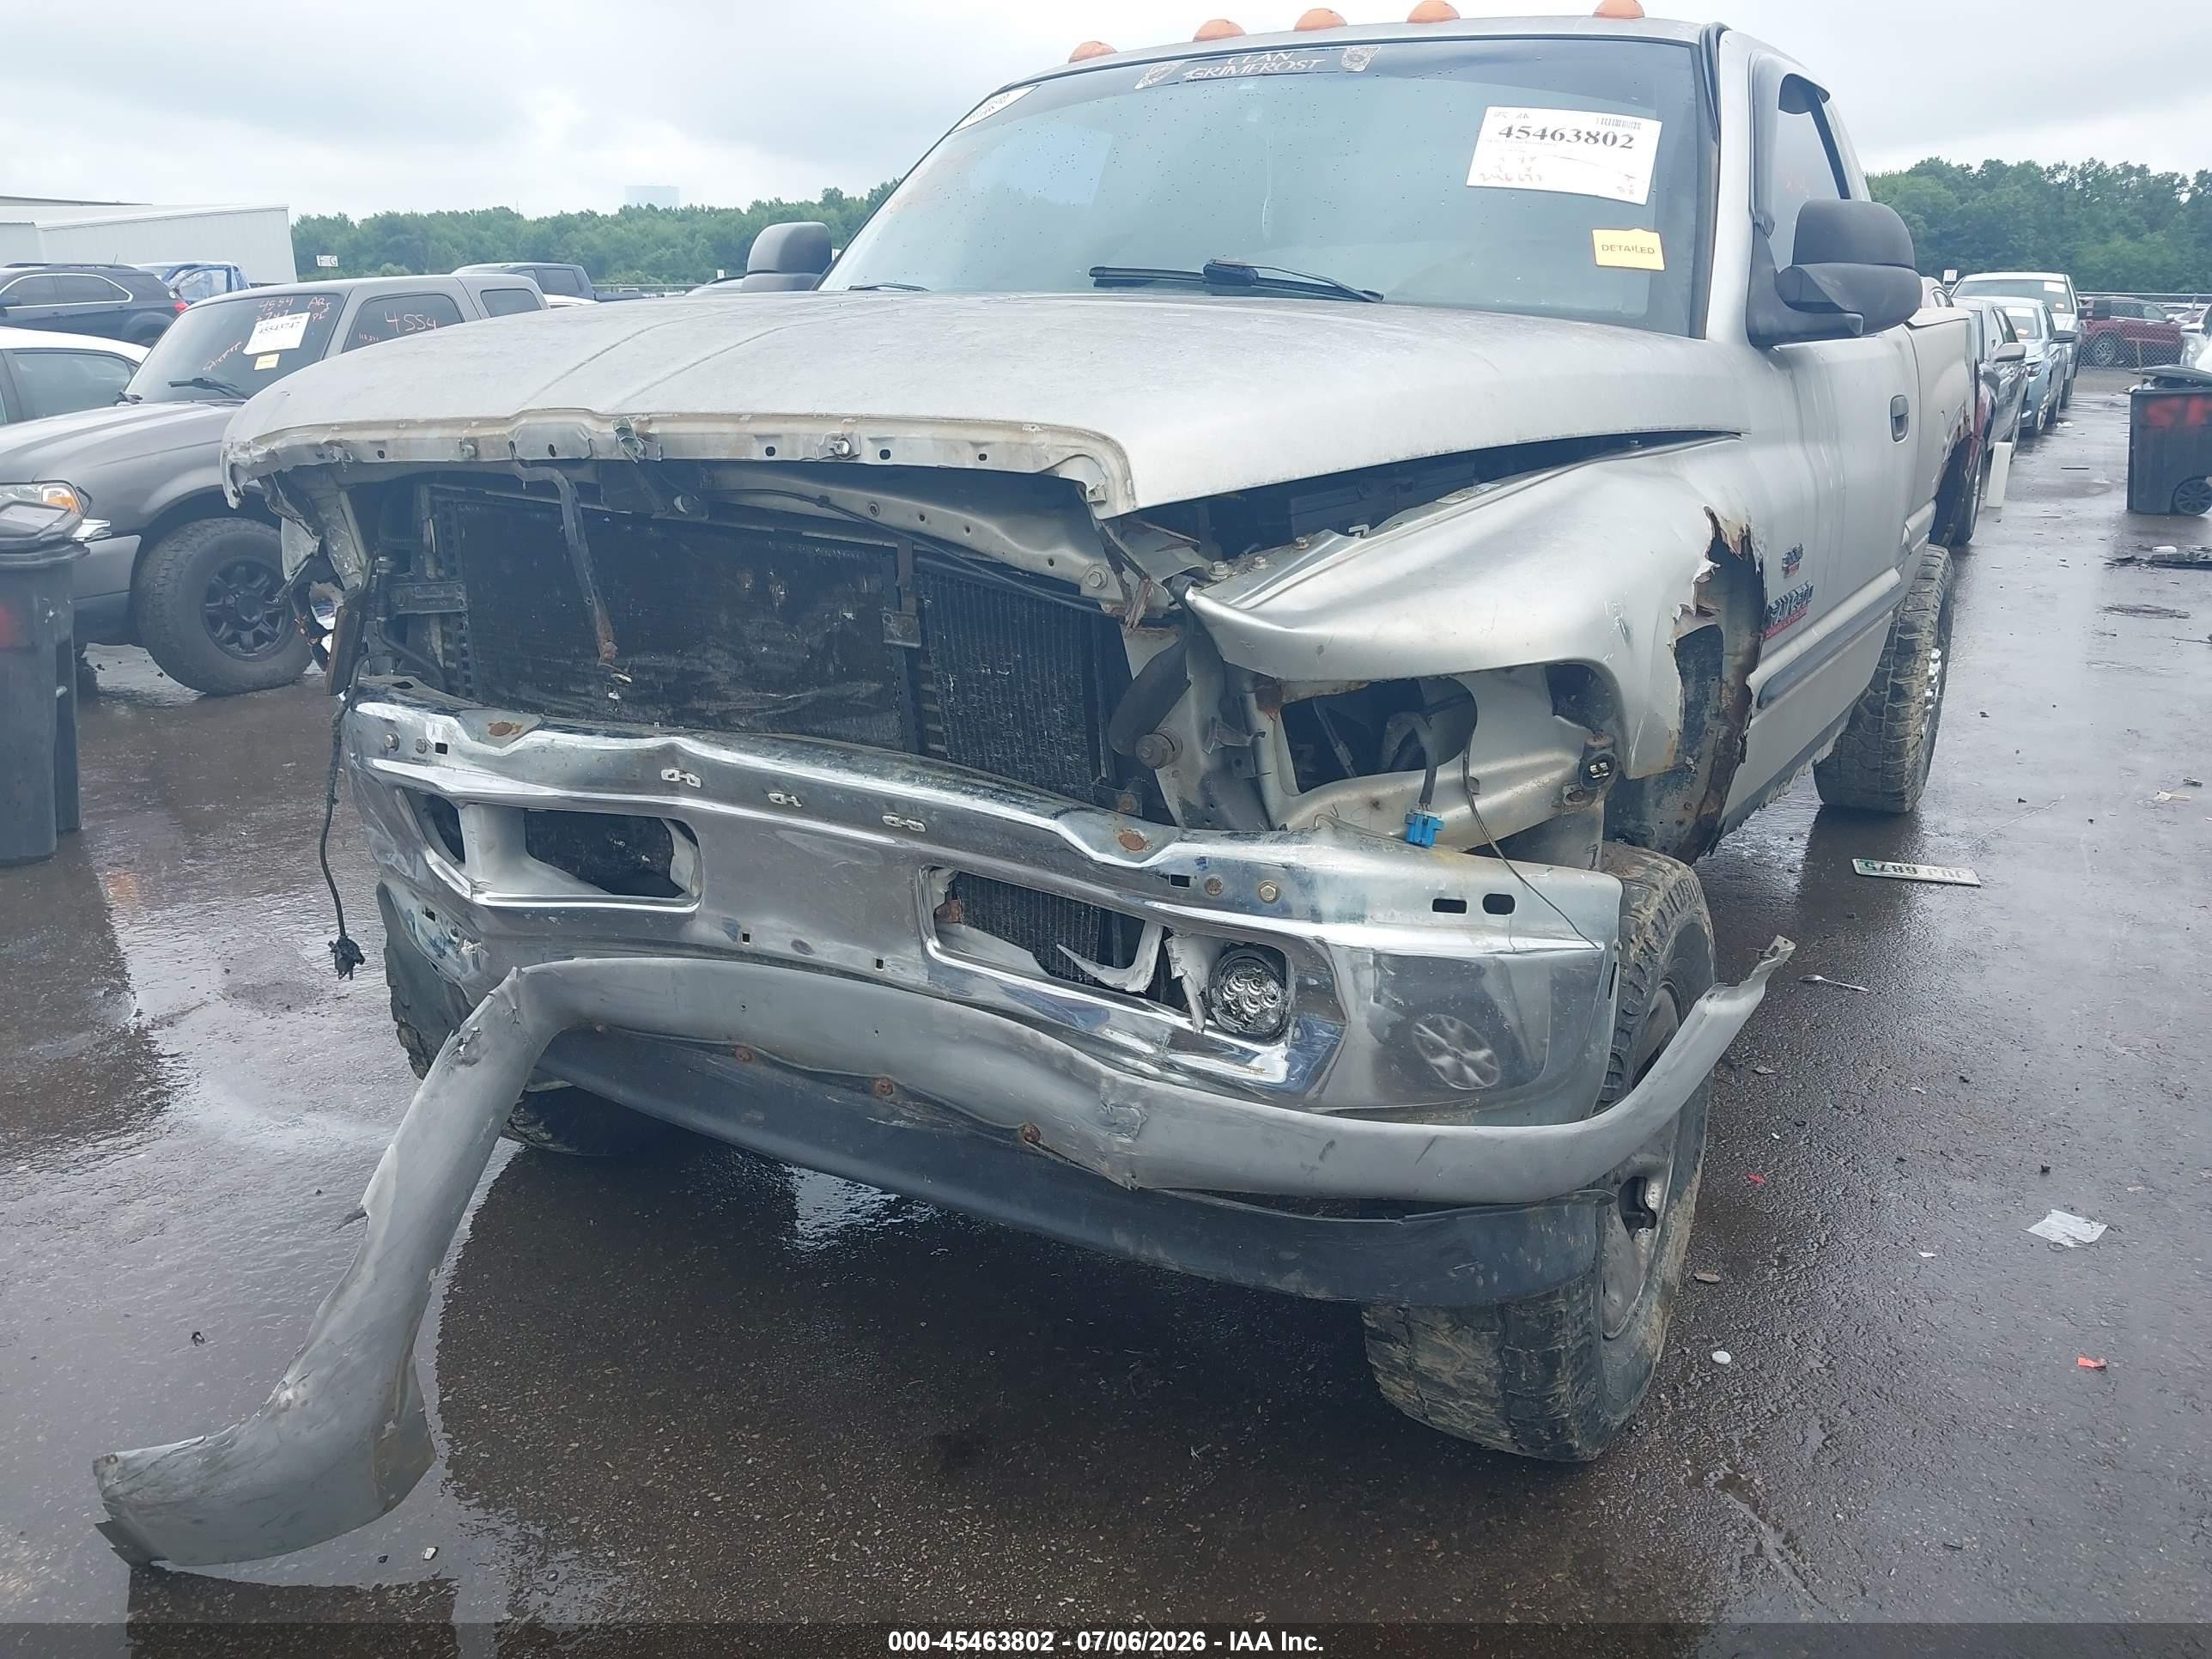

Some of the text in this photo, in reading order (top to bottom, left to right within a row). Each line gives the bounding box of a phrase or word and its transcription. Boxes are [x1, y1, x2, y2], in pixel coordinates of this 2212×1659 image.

[1227, 52, 1294, 65] CLAN
[1183, 58, 1326, 79] GRIMFROST
[1498, 125, 1634, 149] 45463802
[1601, 244, 1655, 254] DETAILED
[329, 256, 337, 266] G
[384, 311, 437, 333] 4554
[1863, 860, 1917, 875] 6875
